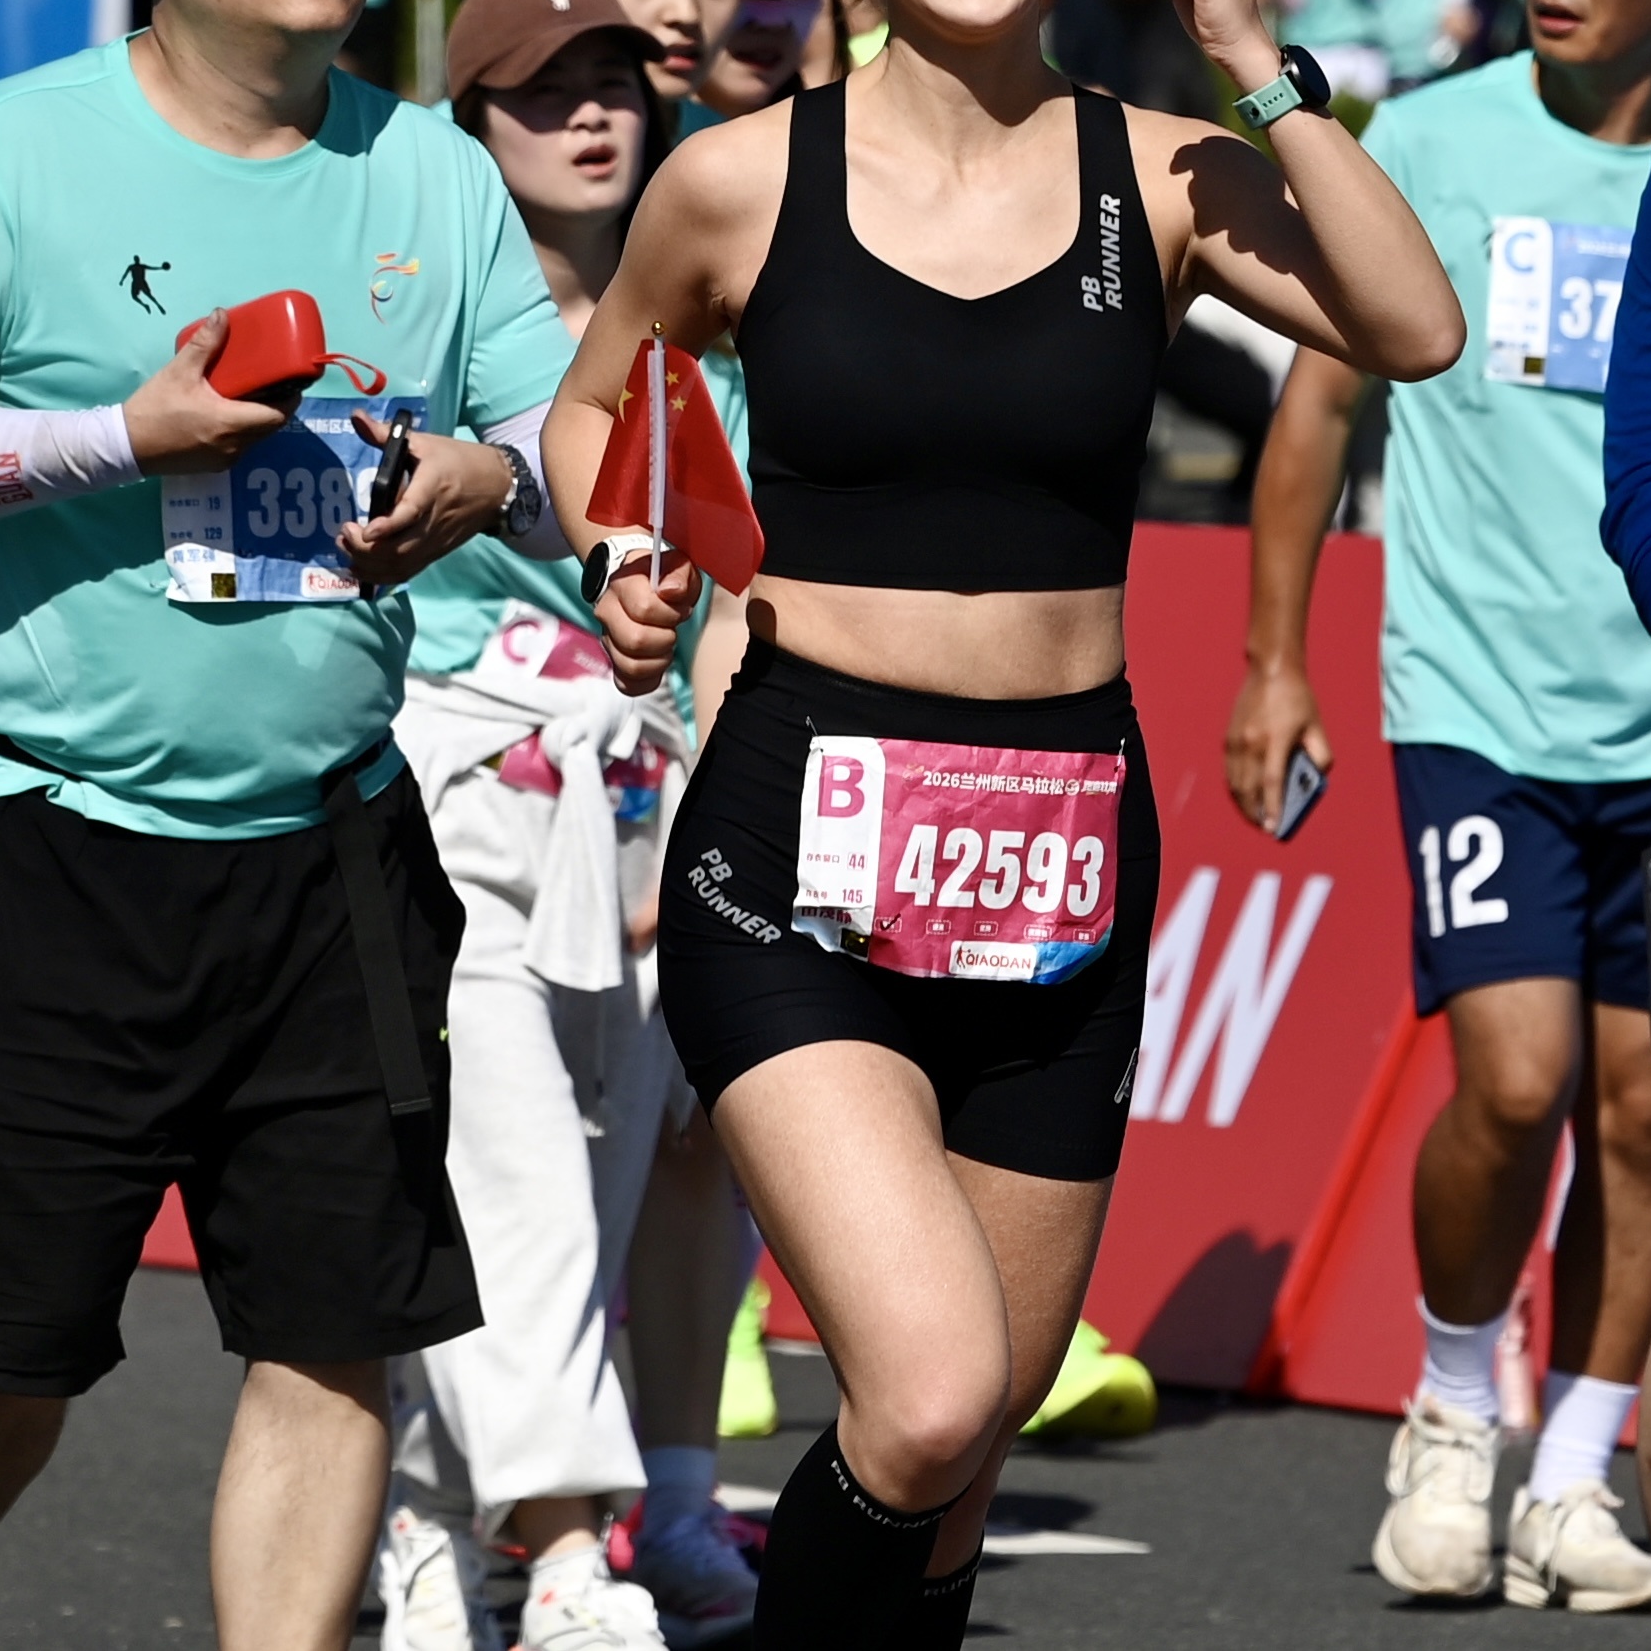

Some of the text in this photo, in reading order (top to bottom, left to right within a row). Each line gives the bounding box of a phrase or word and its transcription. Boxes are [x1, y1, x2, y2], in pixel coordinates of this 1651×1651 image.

[1100, 193, 1123, 311] RUNNER
[1504, 231, 1537, 273] C
[1081, 275, 1104, 313] PB
[317, 576, 360, 591] QIAODA
[503, 619, 543, 666] C
[817, 755, 866, 818] B
[922, 770, 1066, 796] 2026兰州新区马拉松
[700, 847, 734, 883] PB
[848, 853, 866, 870] 44
[894, 823, 1106, 918] 42593
[1418, 813, 1510, 939] 12
[687, 864, 783, 945] RUNNER
[842, 888, 864, 904] 145
[965, 953, 1032, 970] QIAODAN
